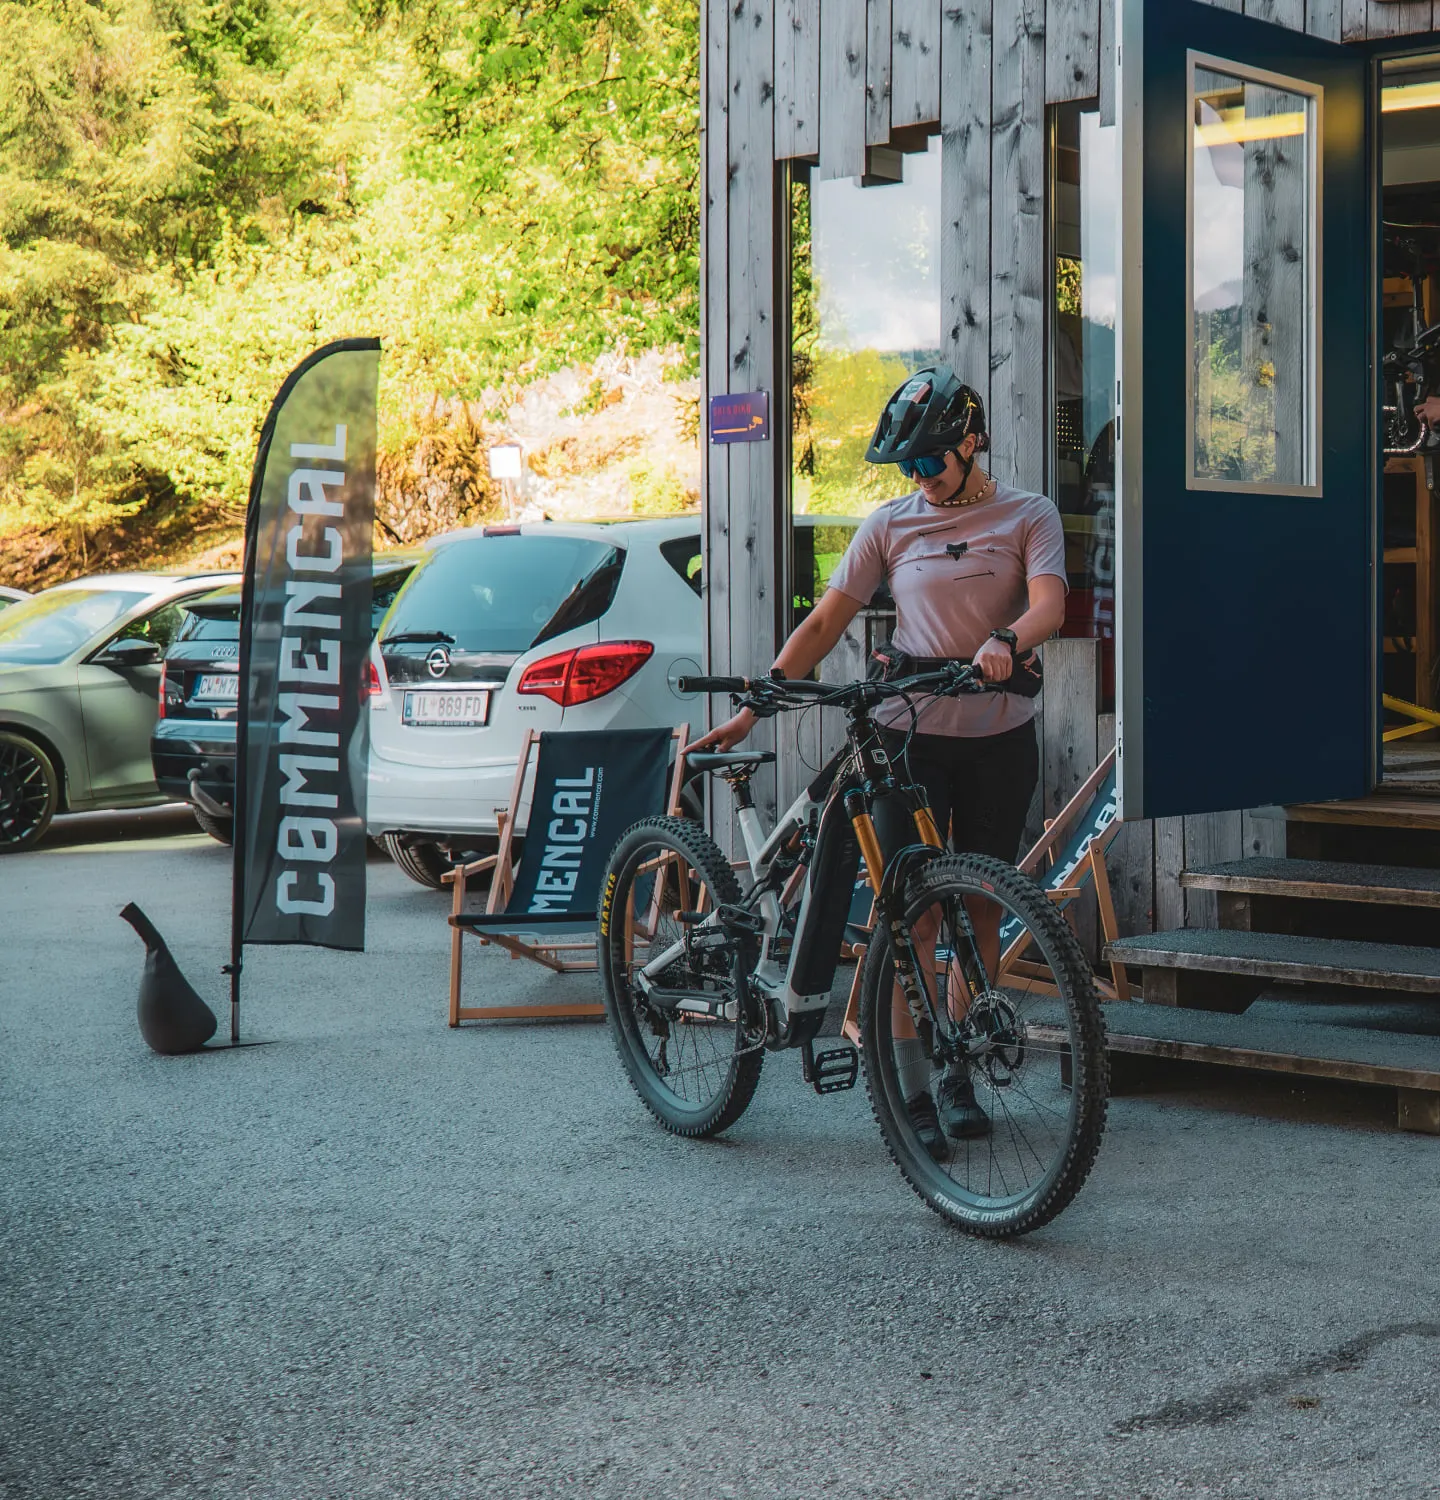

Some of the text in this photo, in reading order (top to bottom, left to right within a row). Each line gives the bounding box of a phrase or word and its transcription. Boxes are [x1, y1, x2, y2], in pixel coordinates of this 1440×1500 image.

[276, 423, 349, 917] COMMENCAL
[416, 696, 481, 717] IL 869 FD
[589, 766, 605, 839] www.commencal.com
[600, 872, 617, 937] MAXXIS
[933, 1191, 978, 1221] MAGIC
[980, 1206, 1020, 1222] MARY
